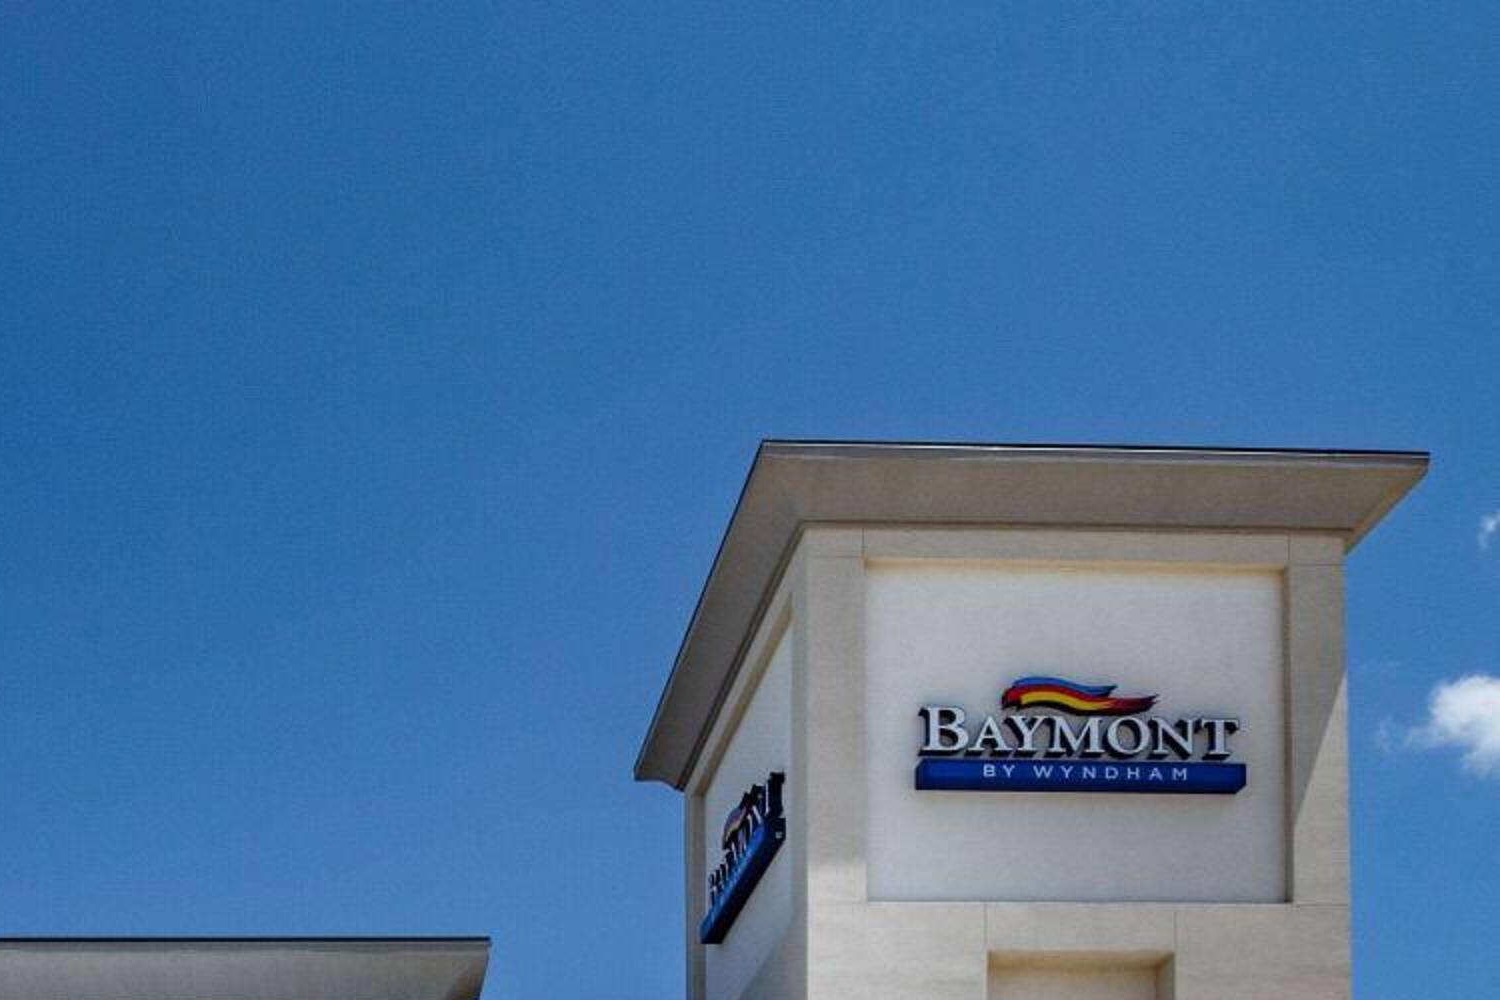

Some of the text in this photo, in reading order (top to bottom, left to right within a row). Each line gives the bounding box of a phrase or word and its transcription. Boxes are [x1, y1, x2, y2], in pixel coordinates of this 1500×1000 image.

[919, 706, 1239, 757] BAYMONT
[983, 765, 1189, 781] BY WYNDHAM
